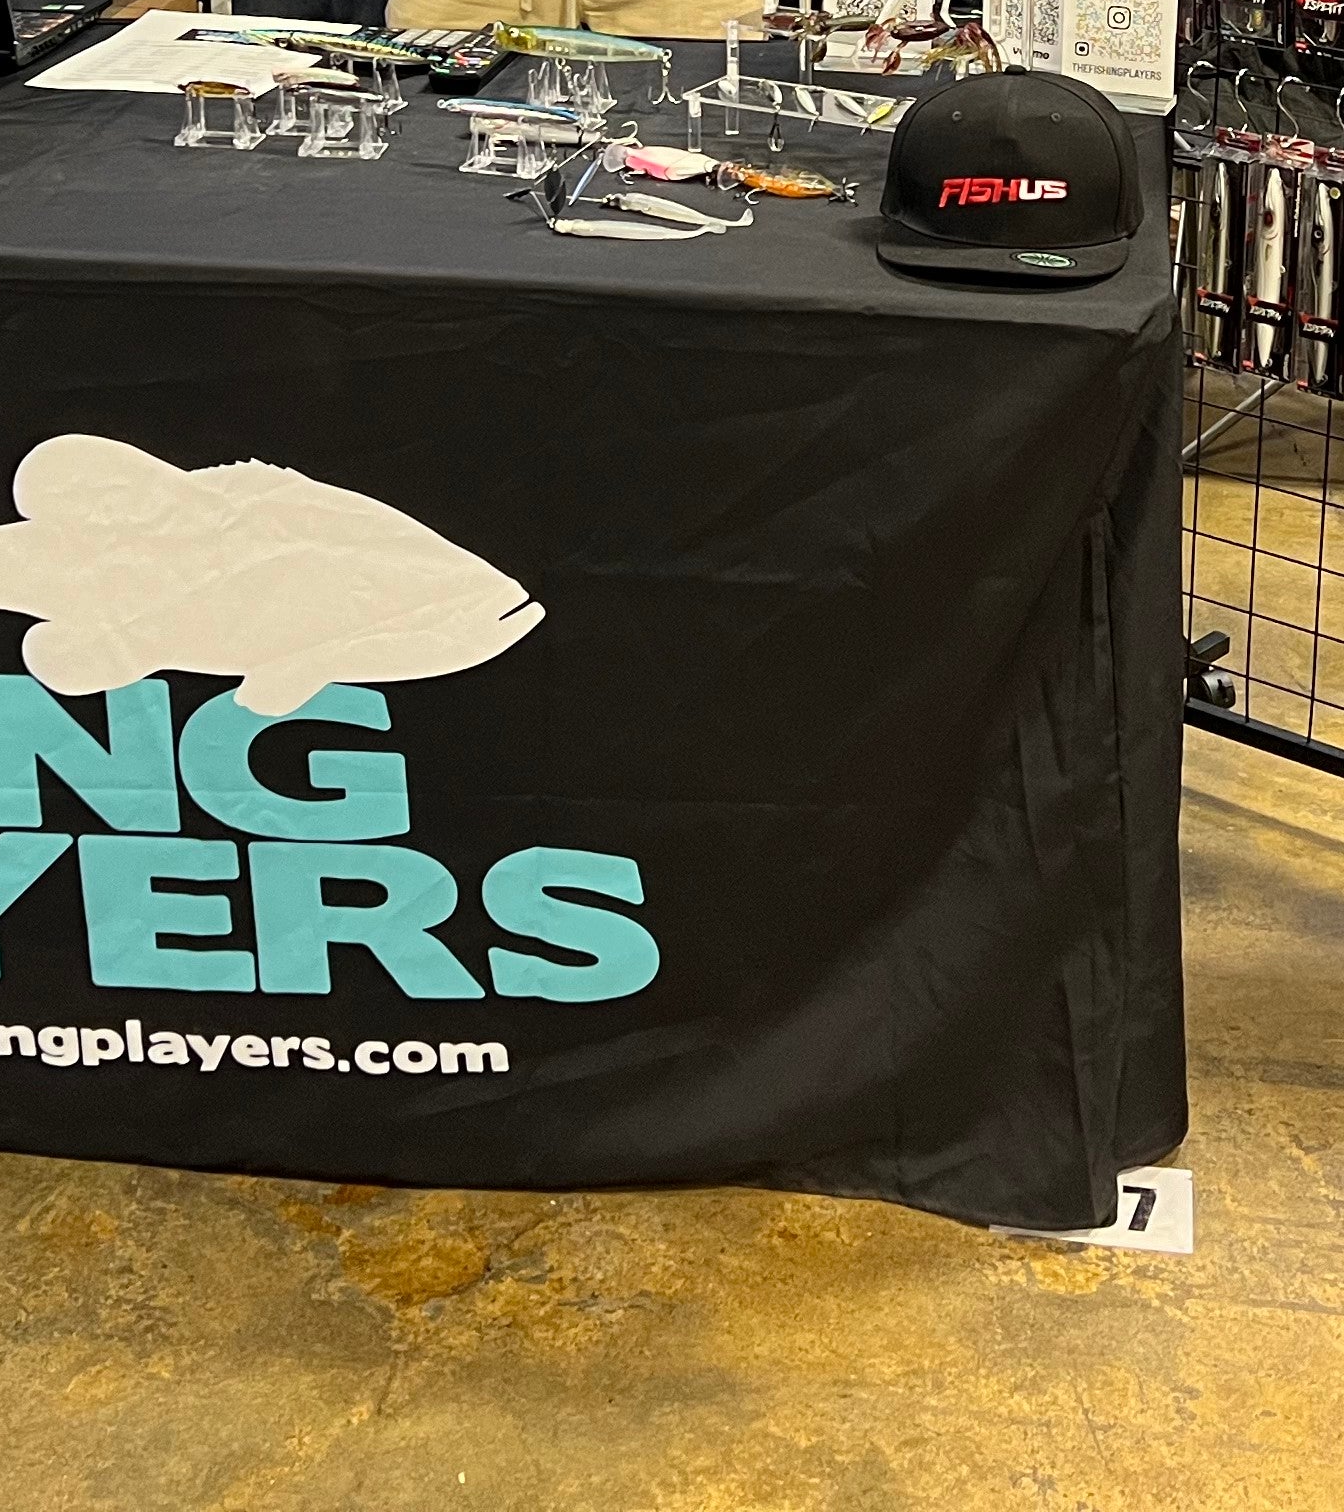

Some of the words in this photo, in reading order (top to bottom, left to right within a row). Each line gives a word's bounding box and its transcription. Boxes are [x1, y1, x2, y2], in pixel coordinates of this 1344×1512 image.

[1013, 46, 1051, 61] vmo
[1072, 62, 1163, 82] THEFISHINGPLAYERS
[939, 178, 1069, 209] FISHUS
[1122, 1185, 1157, 1232] 7
